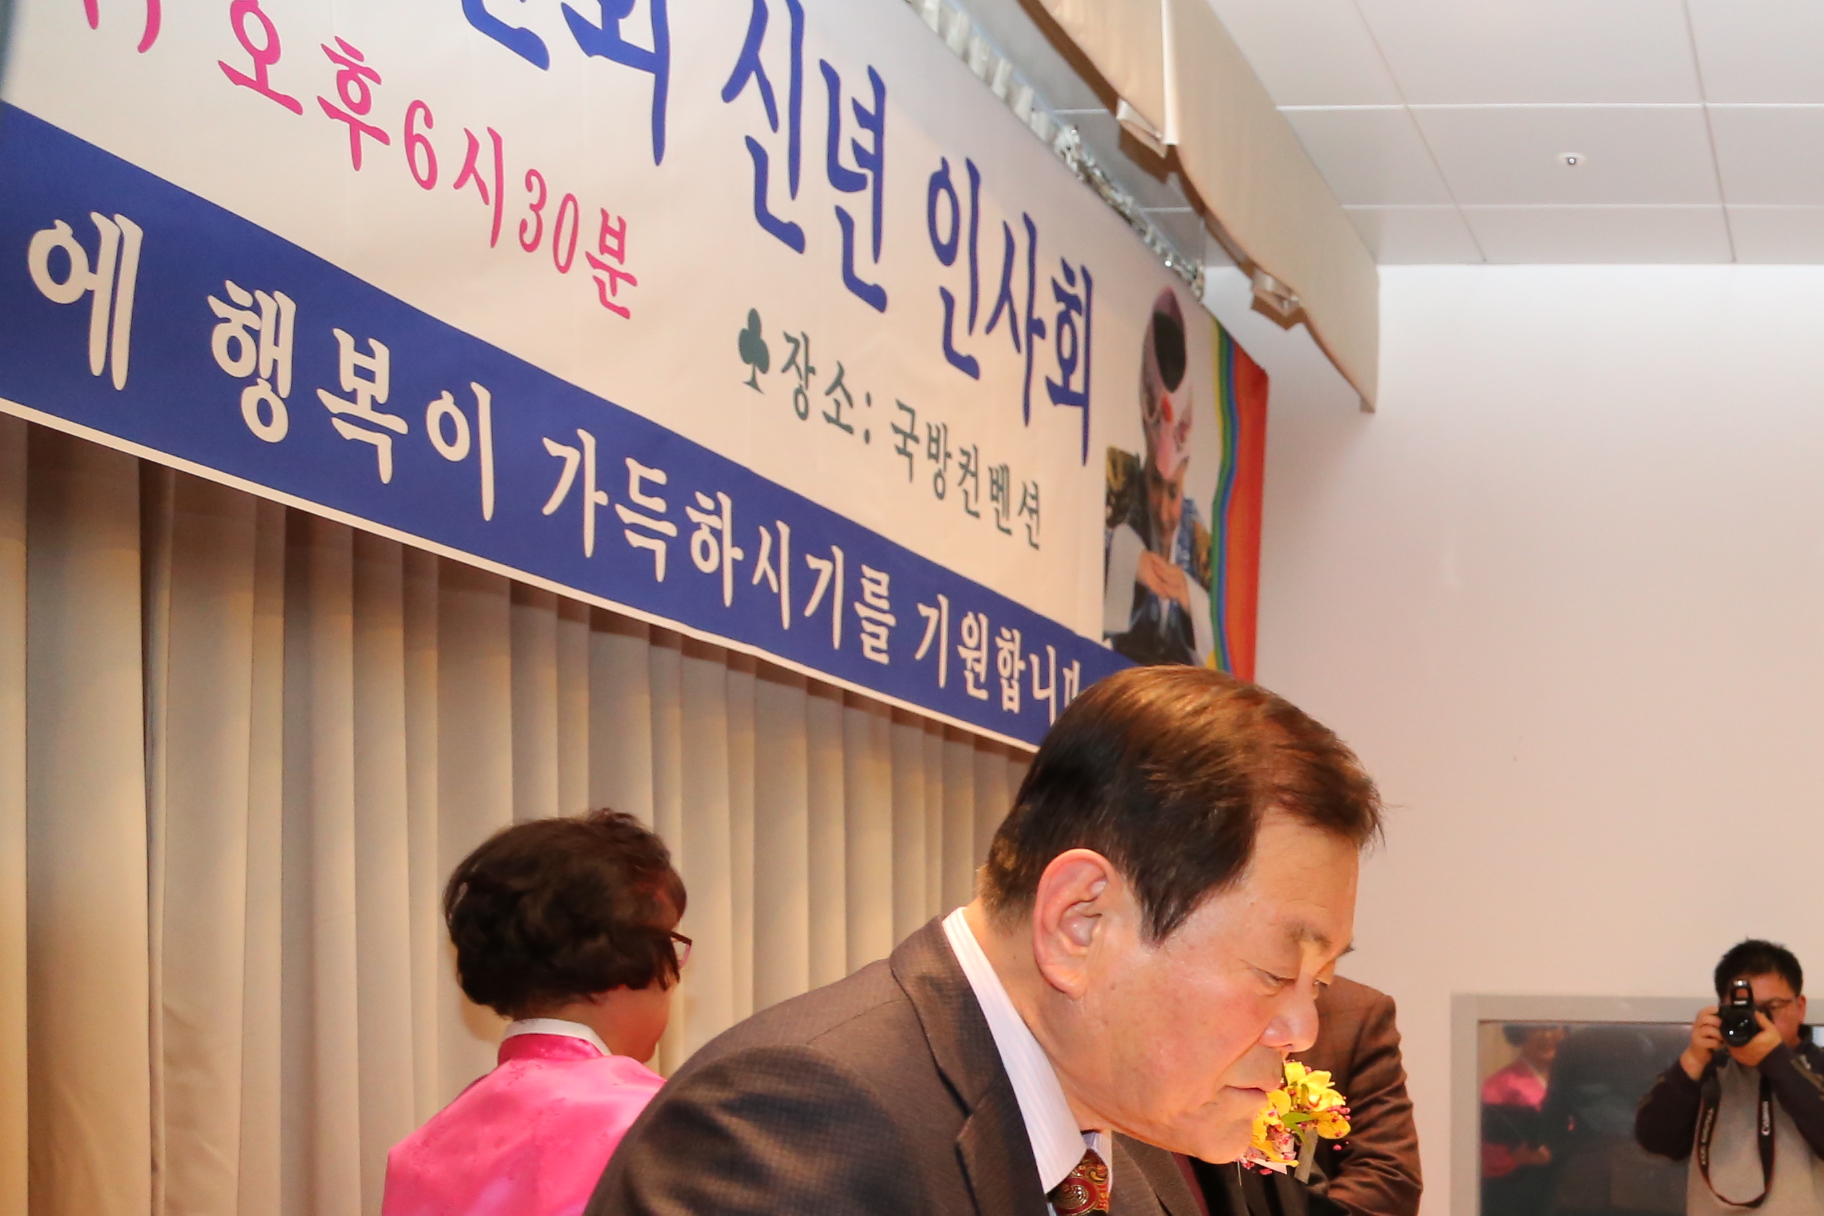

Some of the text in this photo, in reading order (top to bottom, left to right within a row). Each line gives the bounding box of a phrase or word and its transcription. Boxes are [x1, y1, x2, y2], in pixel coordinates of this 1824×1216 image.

[28, 212, 143, 390] 에
[207, 280, 495, 522] 행복이
[542, 428, 897, 665] 가득하시기를
[721, 0, 887, 313] 신년
[928, 156, 1093, 466] 인사회
[781, 331, 1040, 551] 장소: 국방컨벤션
